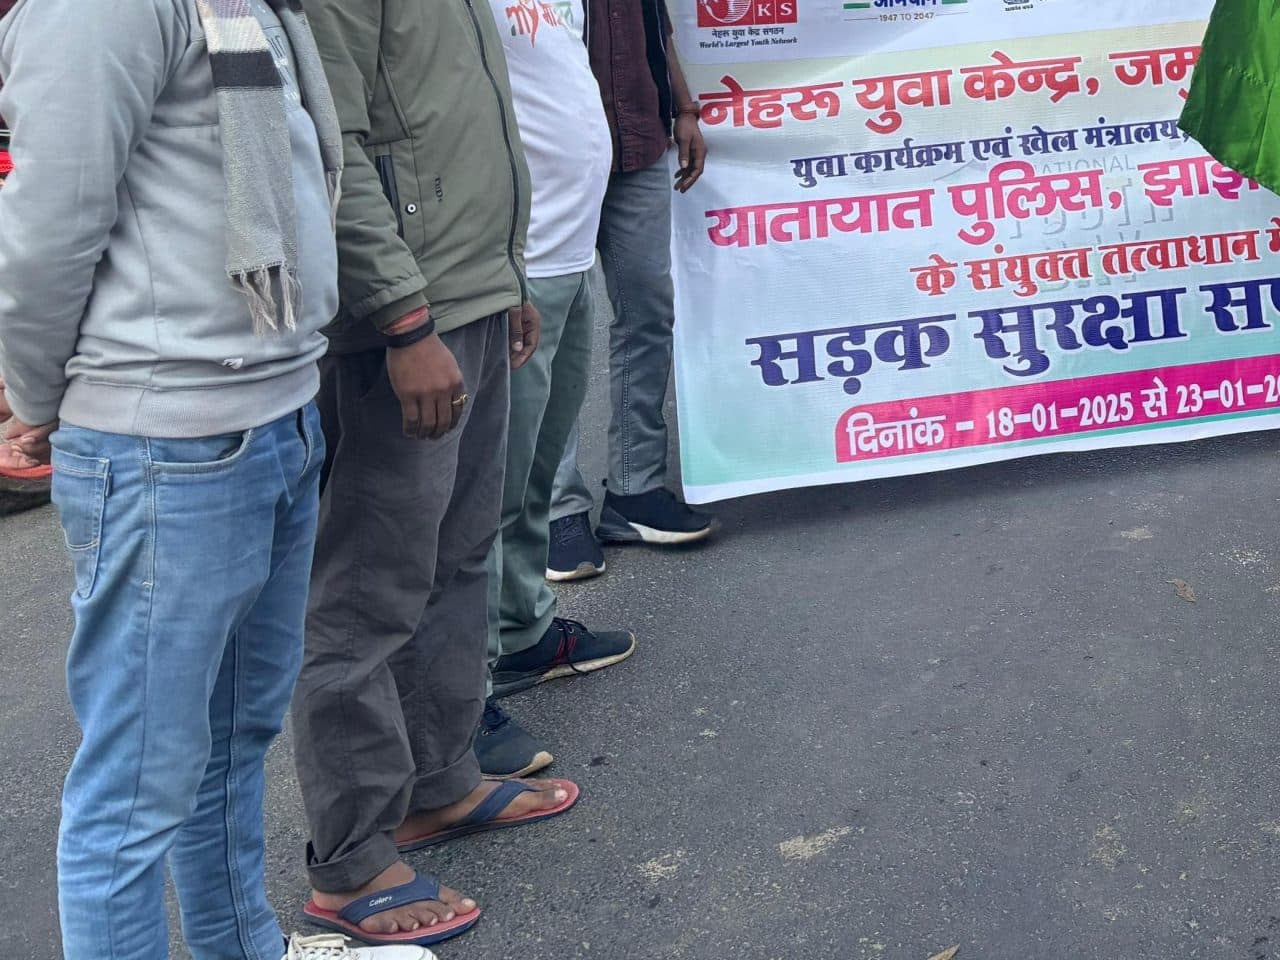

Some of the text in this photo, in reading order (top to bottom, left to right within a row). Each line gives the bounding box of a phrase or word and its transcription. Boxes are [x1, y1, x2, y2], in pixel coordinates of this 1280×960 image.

[879, 12, 934, 22] 1947 TO 2047
[698, 75, 843, 129] नेहरू
[852, 69, 952, 134] युवा
[960, 50, 1100, 103] केन्द्र,
[790, 153, 849, 188] युवा
[850, 138, 965, 174] कार्यक्रम
[969, 126, 1013, 162] एवं
[1019, 126, 1079, 156] खेल
[705, 188, 935, 248] यातायात
[947, 160, 1122, 246] पुलिस,
[909, 253, 958, 296] के
[964, 243, 1093, 298] संयुक्त
[1098, 228, 1260, 277] तत्वाधान
[745, 313, 957, 395] सड़क
[968, 287, 1187, 377] सुरक्षा
[846, 407, 946, 456] दिनांक
[986, 388, 1134, 439] 18-01-2025
[1141, 376, 1168, 419] से
